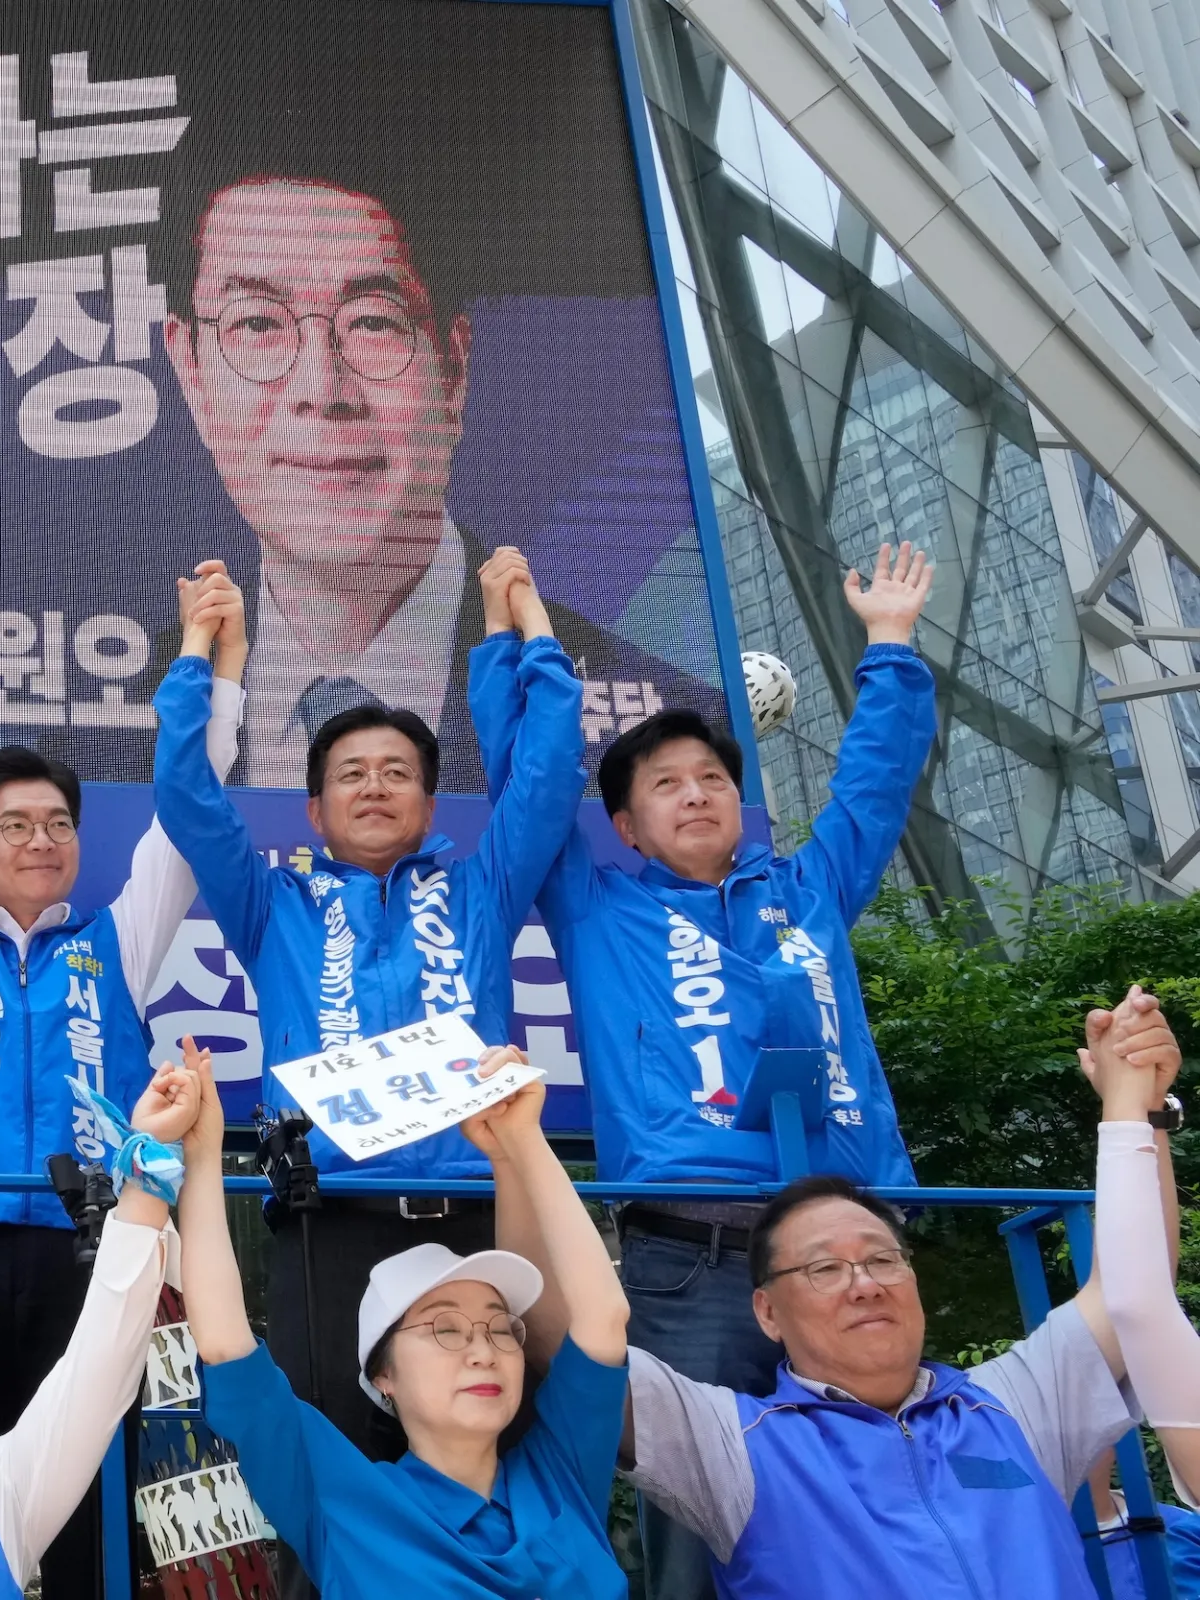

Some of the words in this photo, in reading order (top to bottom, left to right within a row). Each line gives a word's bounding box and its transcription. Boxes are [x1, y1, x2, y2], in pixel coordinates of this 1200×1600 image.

[582, 680, 664, 742] 주당
[66, 954, 104, 977] 착착!
[303, 1053, 364, 1079] 기호
[316, 1056, 496, 1127] 정원오
[832, 1108, 864, 1127] 후보
